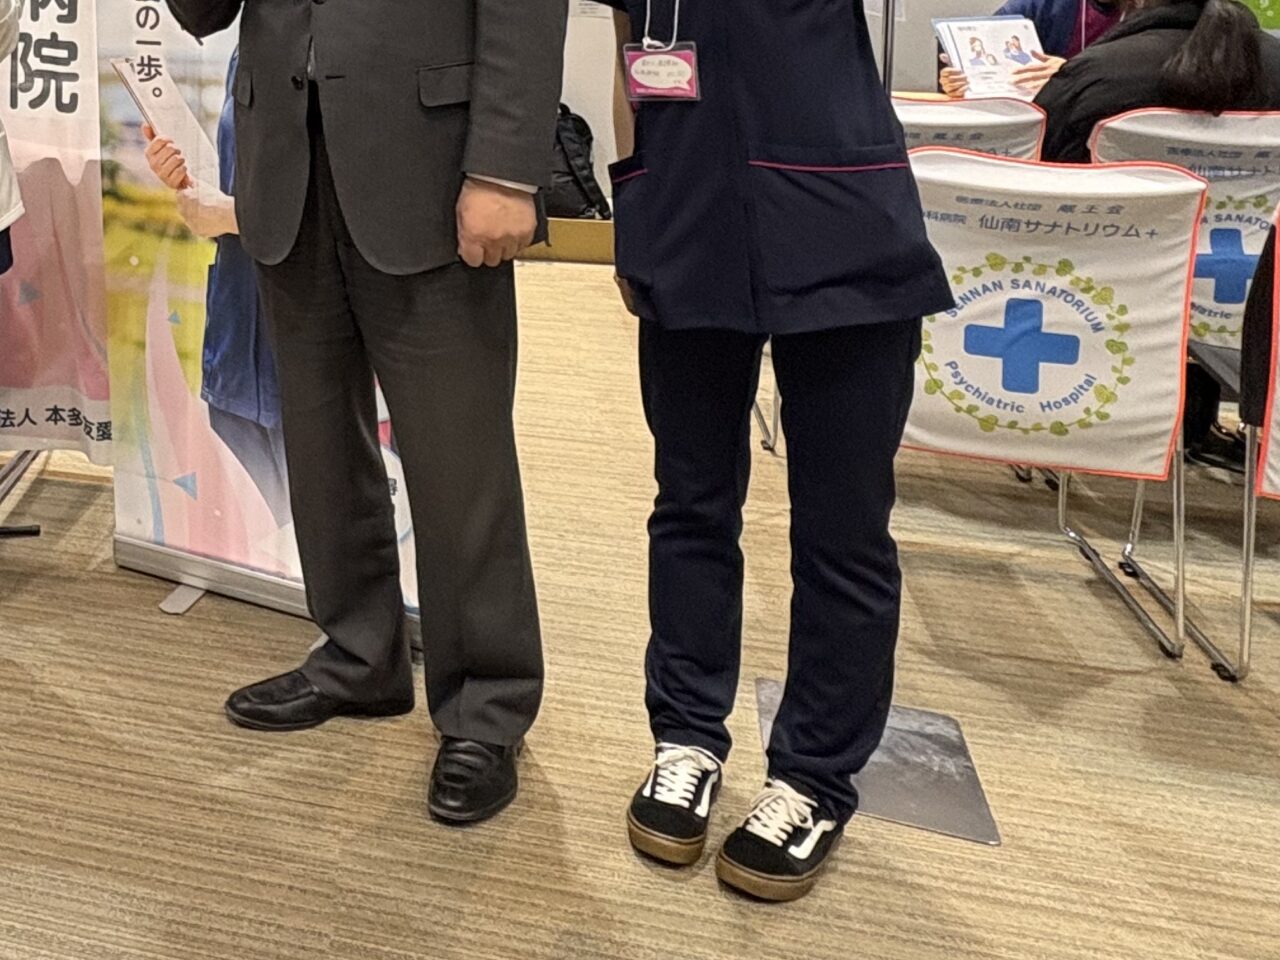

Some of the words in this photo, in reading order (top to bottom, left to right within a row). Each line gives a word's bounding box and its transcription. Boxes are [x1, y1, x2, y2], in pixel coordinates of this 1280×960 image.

[955, 195, 1043, 212] 医療法人社団
[944, 279, 1004, 318] SENNAN
[1010, 278, 1105, 334] SANATORIUM
[945, 360, 1025, 413] Psychiatric
[1039, 373, 1097, 413] Hospital
